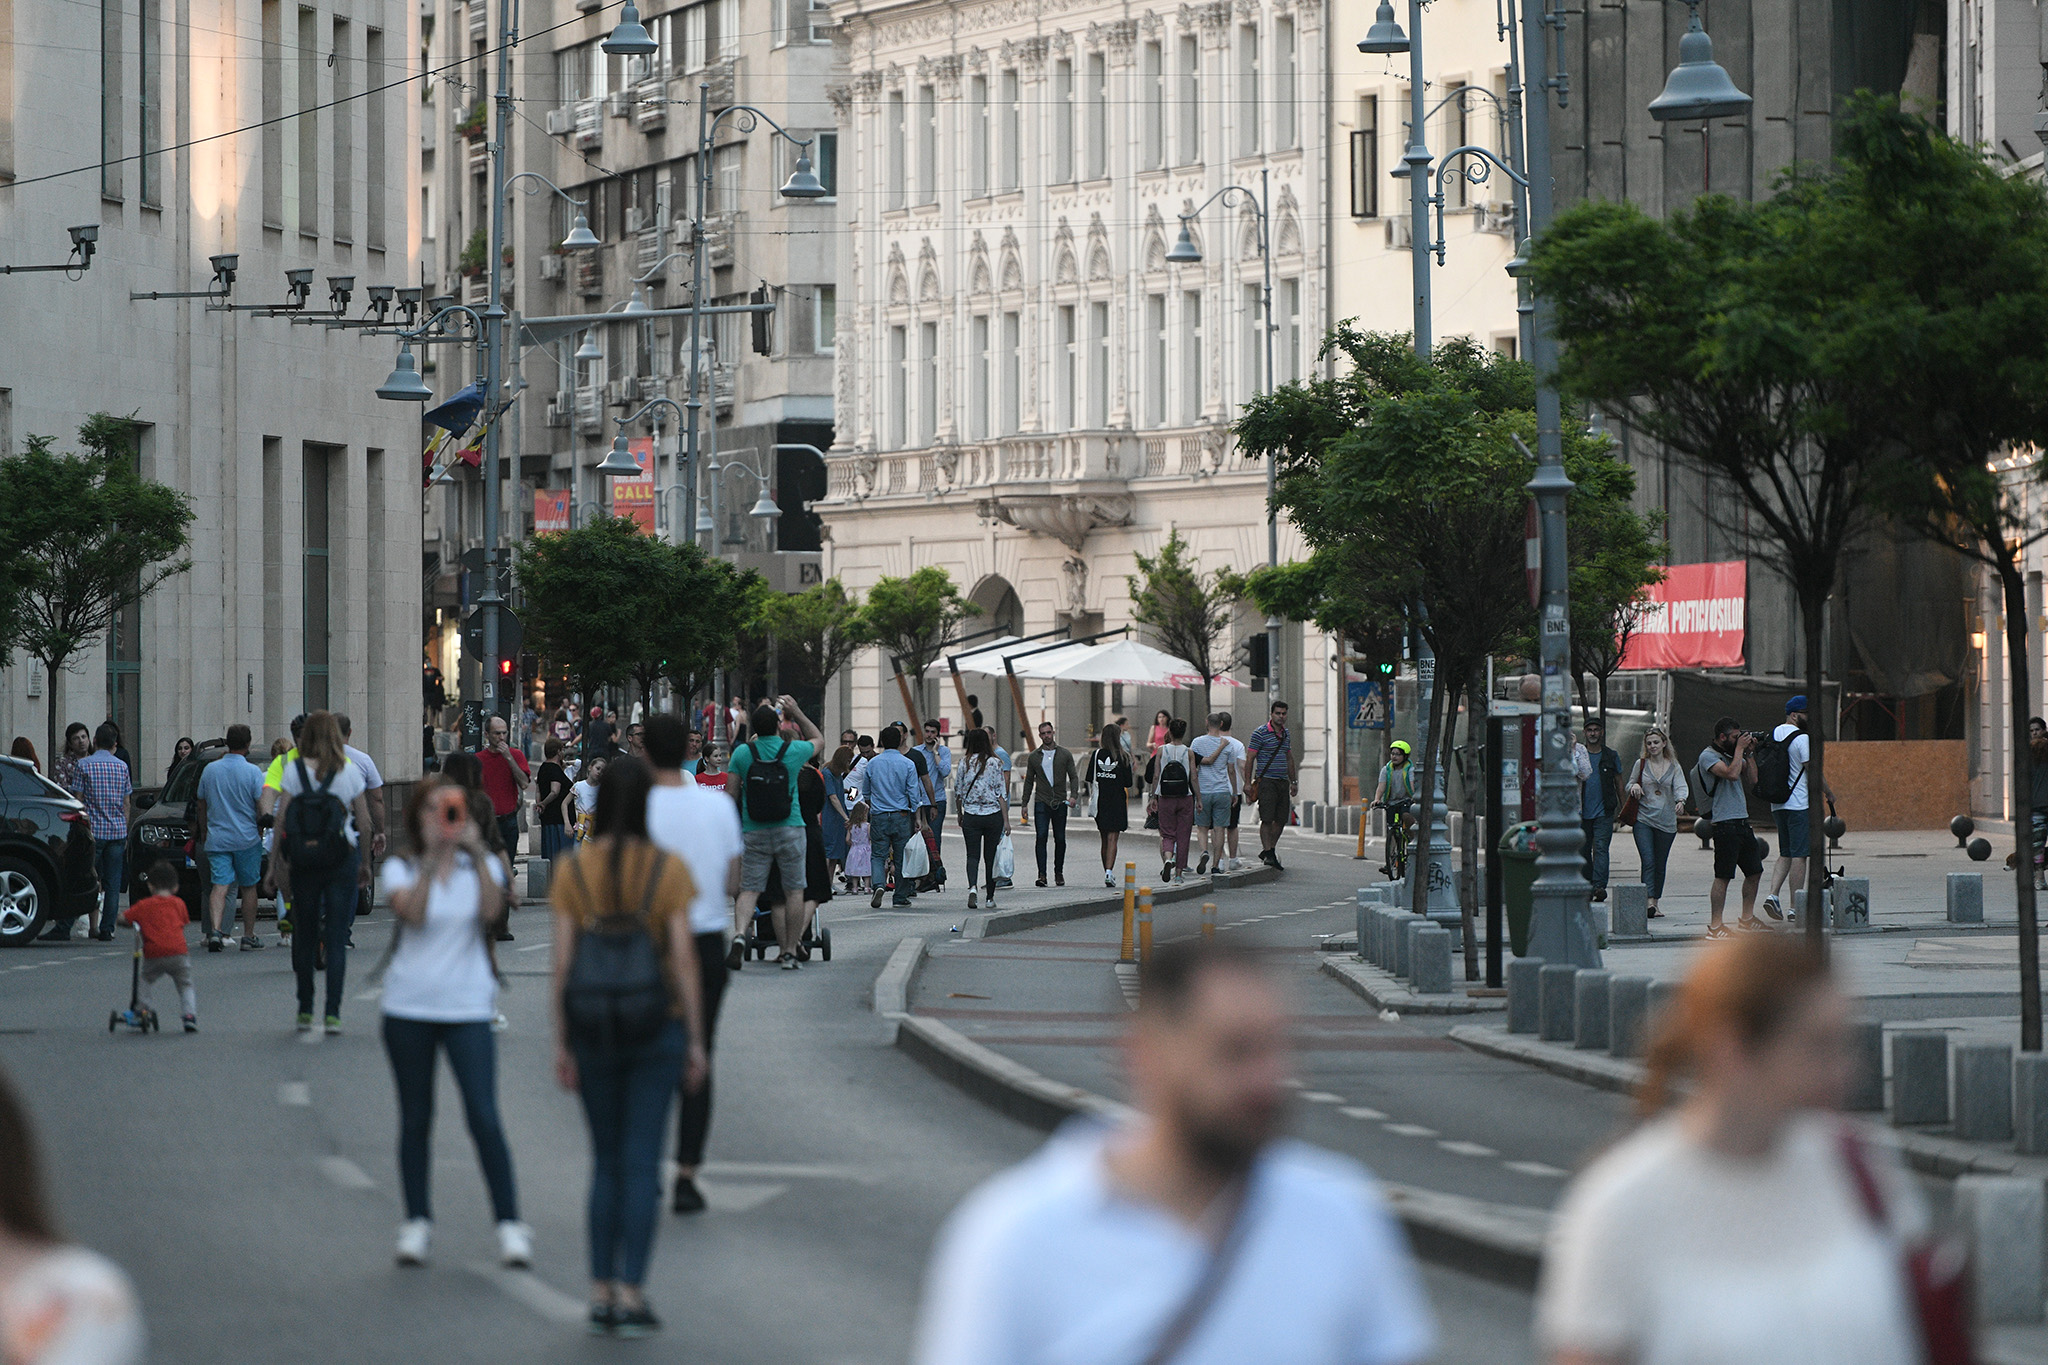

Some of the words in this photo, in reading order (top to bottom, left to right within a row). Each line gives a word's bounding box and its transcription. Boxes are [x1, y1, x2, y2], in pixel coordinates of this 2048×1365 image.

[615, 485, 653, 500] CALL
[1547, 620, 1567, 633] BNE
[1420, 659, 1435, 669] BNE
[700, 782, 726, 791] Super
